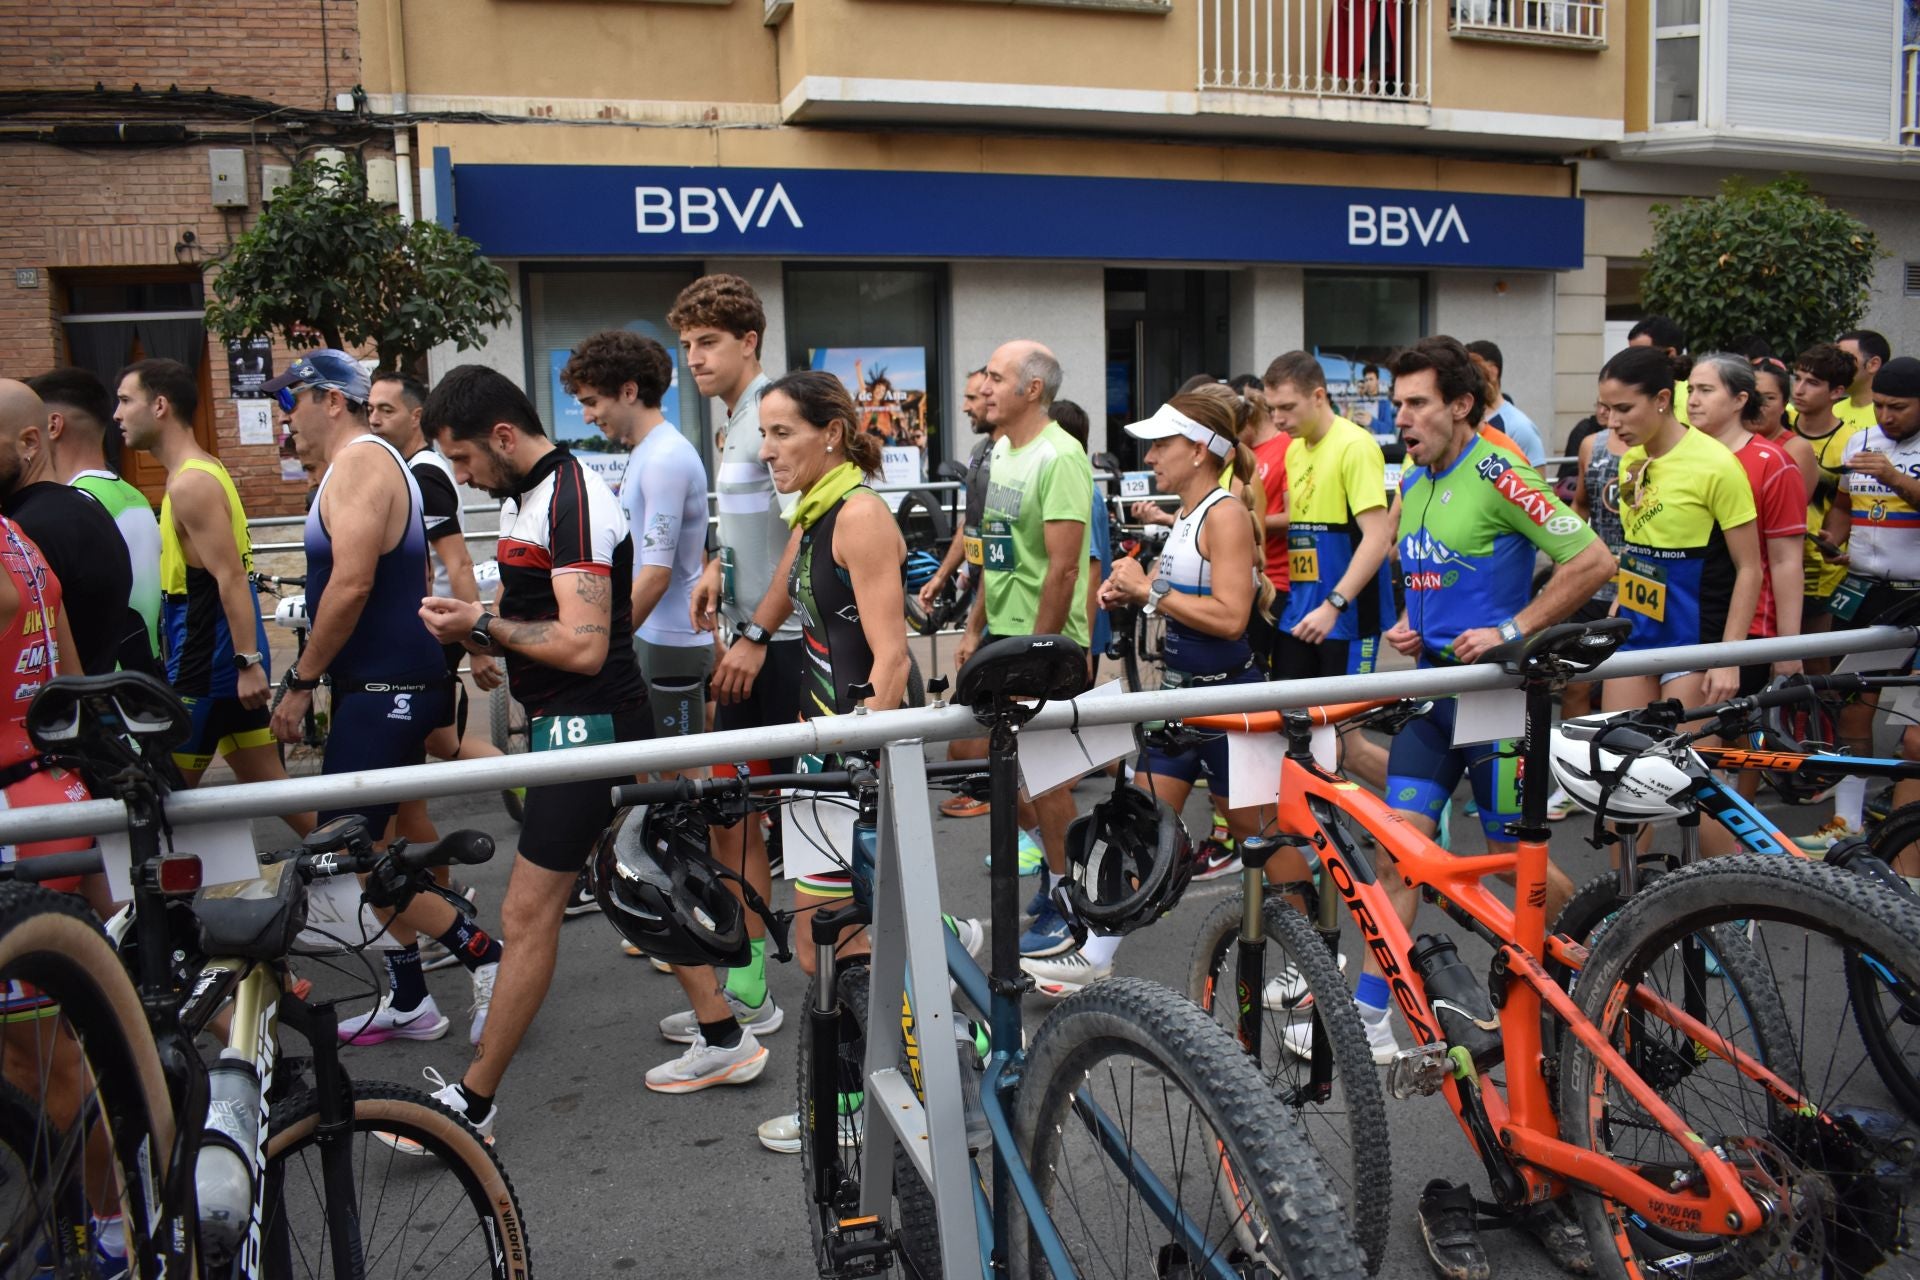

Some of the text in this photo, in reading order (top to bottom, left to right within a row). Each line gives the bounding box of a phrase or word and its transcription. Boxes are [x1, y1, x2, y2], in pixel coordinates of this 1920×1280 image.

[635, 182, 804, 233] BBVA
[1348, 204, 1470, 247] BBVA
[1125, 481, 1145, 491] 129
[989, 544, 1005, 563] 34
[1292, 556, 1313, 574] 121
[1662, 551, 1686, 559] RIOJA
[1625, 580, 1659, 610] 104
[1831, 592, 1850, 610] 27
[549, 716, 589, 747] 18
[1327, 857, 1436, 1047] ORBEA
[501, 1210, 523, 1262] Vittoria
